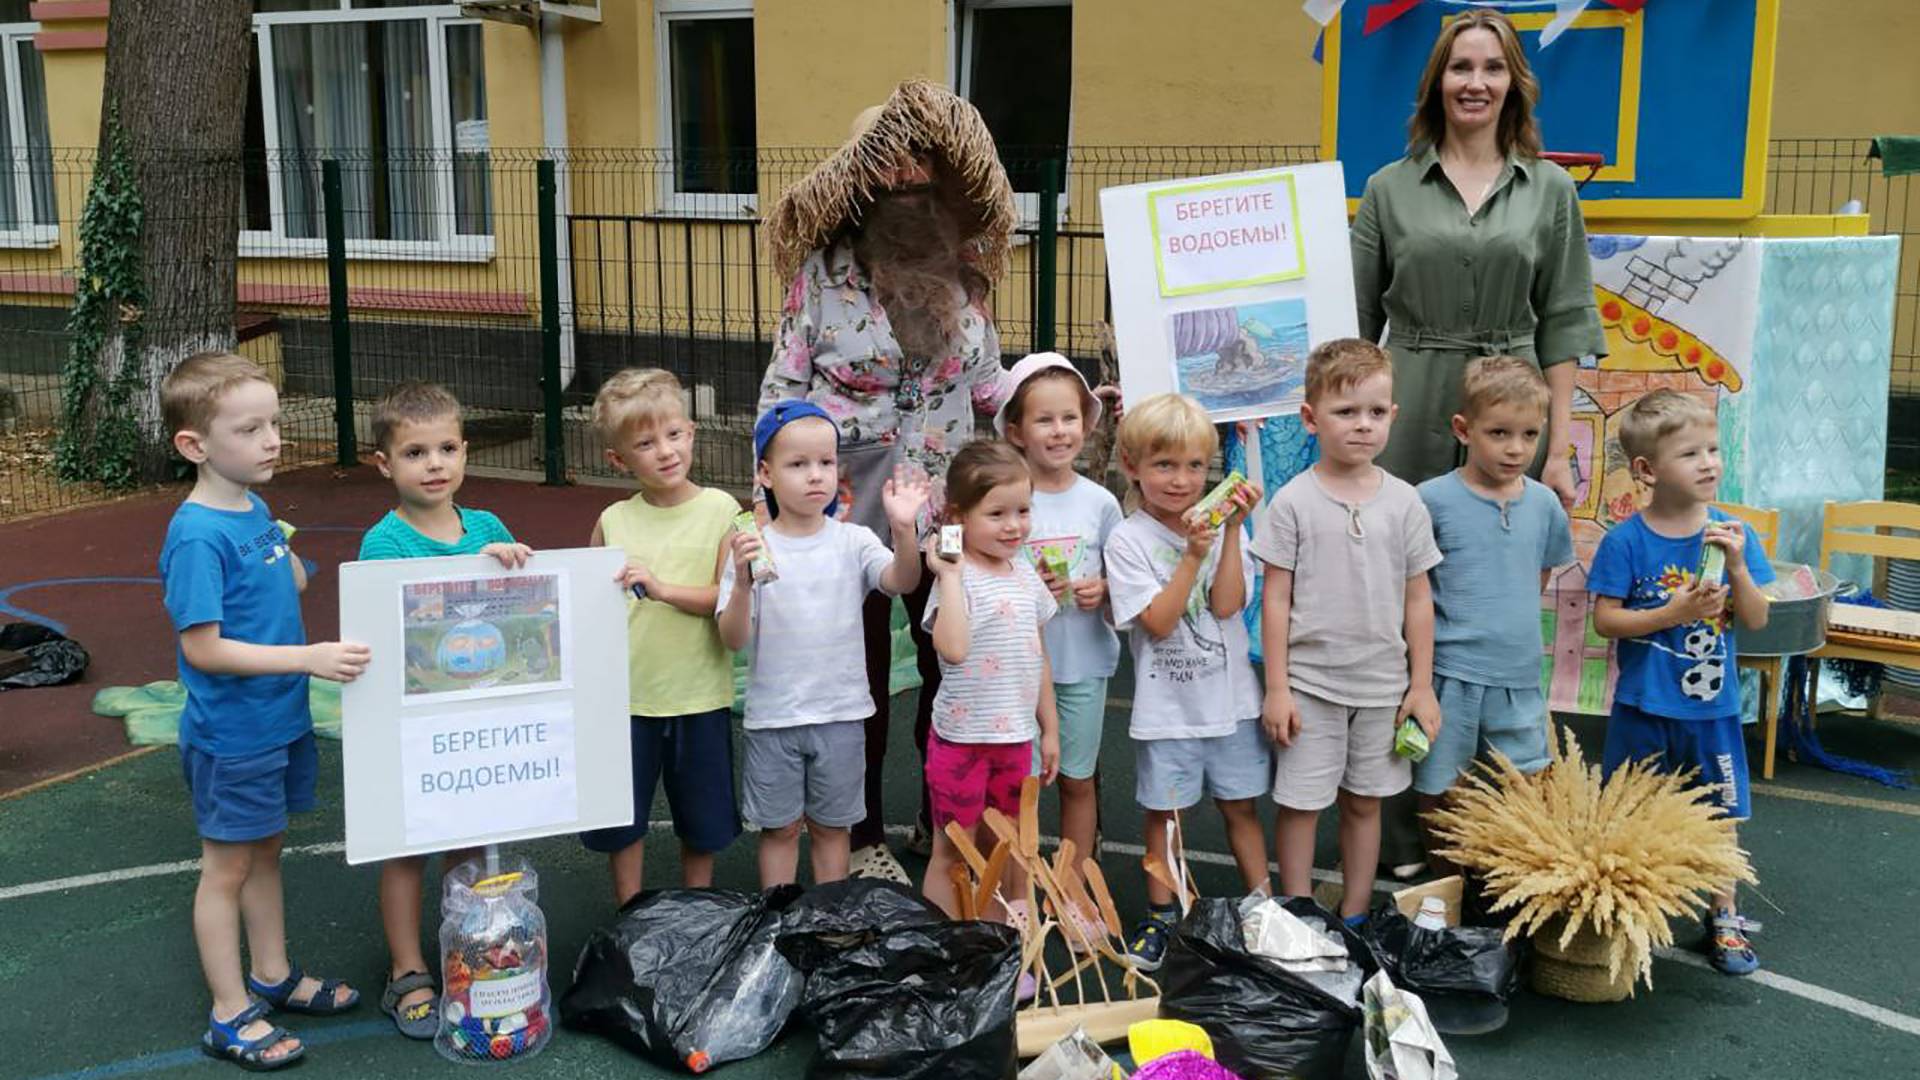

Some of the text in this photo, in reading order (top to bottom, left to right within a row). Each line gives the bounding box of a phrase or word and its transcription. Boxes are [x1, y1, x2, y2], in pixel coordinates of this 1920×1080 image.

[1175, 192, 1274, 221] БЕРЕГИТЕ
[1168, 223, 1288, 254] ВОДОЕМЫ!
[1169, 670, 1194, 683] FUN
[432, 722, 548, 755] БЕРЕГИТЕ
[421, 757, 561, 793] ВОДОЕМЫ!
